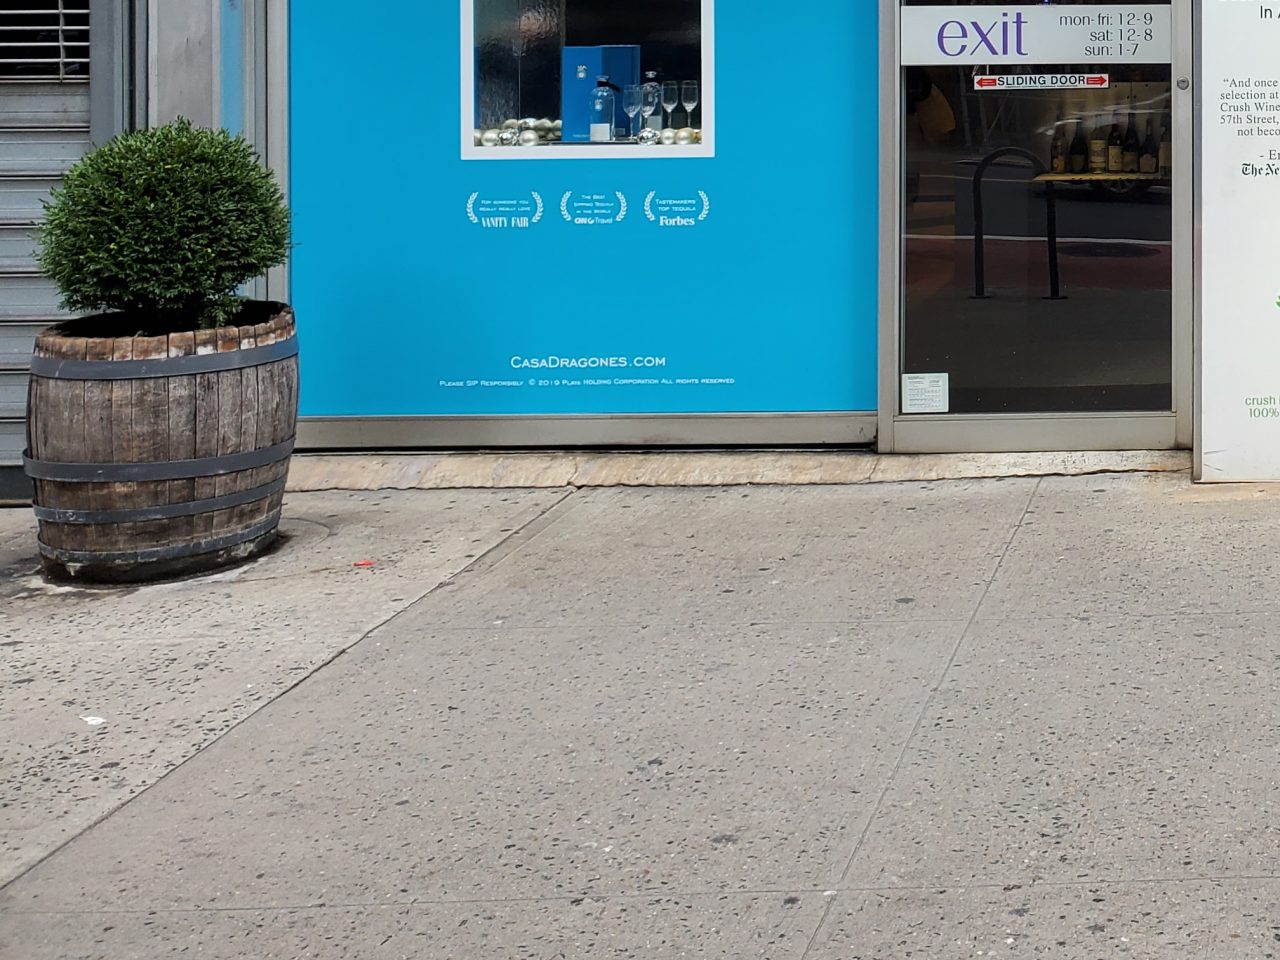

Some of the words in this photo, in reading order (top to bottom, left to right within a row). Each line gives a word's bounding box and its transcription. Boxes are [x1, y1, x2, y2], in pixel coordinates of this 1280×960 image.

[1259, 6, 1273, 19] In
[937, 12, 1028, 57] exit
[1089, 29, 1113, 42] sat:
[1084, 44, 1113, 57] sun:
[997, 76, 1048, 86] SLIDING
[1050, 75, 1086, 85] DOOR
[1220, 90, 1266, 100] selection
[1269, 92, 1279, 100] at
[1220, 102, 1251, 112] Crush
[1254, 102, 1280, 112] Wine
[1220, 114, 1243, 124] 57th
[1246, 114, 1280, 125] Street,
[1237, 127, 1254, 136] not
[1241, 162, 1263, 177] The
[481, 216, 507, 228] VANITY
[511, 216, 529, 228] FAIR
[659, 215, 695, 226] Forbes
[1245, 395, 1276, 406] crush
[1249, 407, 1279, 418] 100%
